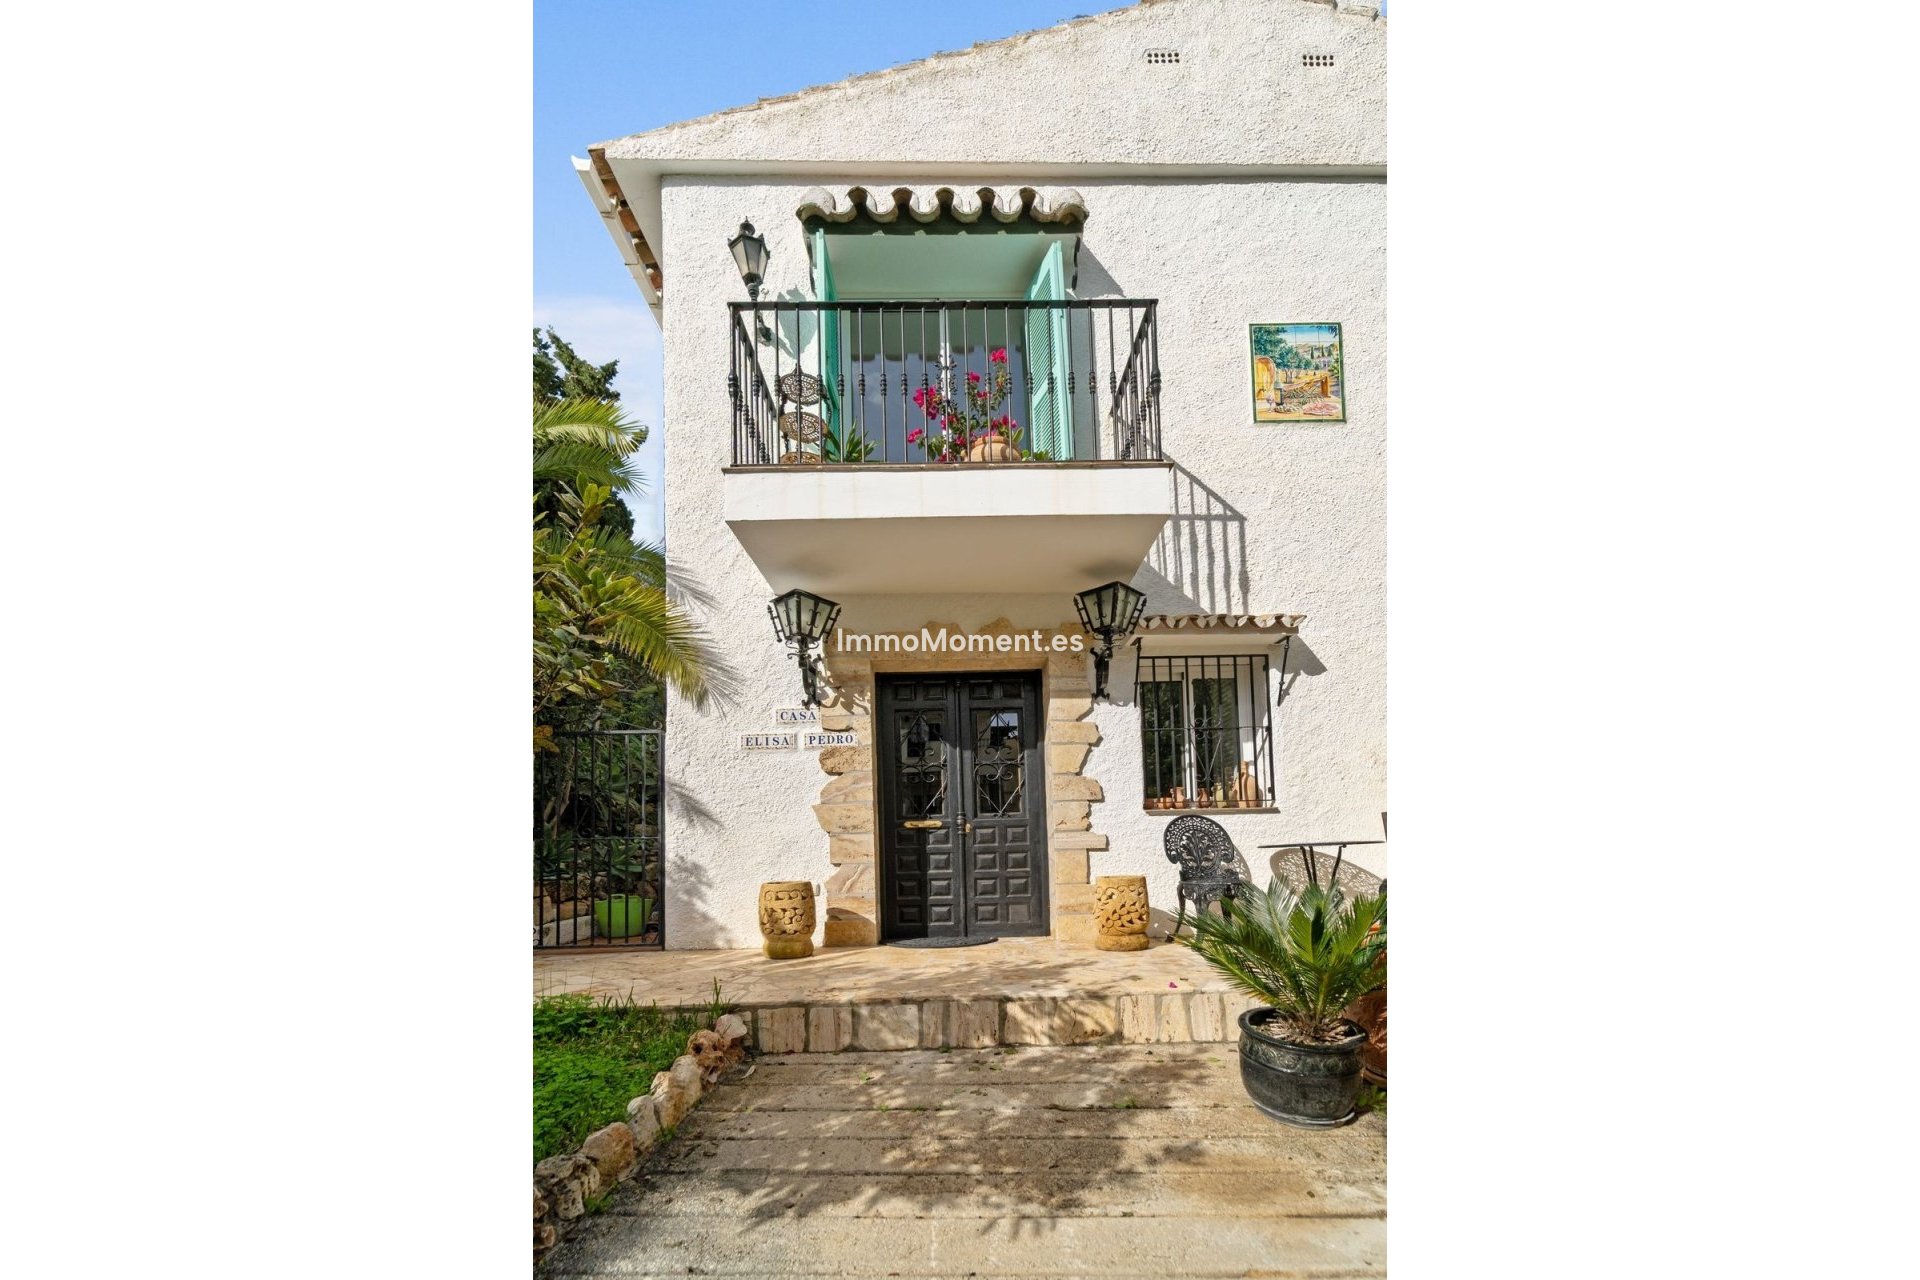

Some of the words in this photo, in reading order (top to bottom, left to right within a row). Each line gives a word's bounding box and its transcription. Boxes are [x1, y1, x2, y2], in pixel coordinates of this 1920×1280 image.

[780, 711, 817, 721] CASA
[745, 736, 790, 747] ELISA
[808, 734, 854, 745] PEDRO
